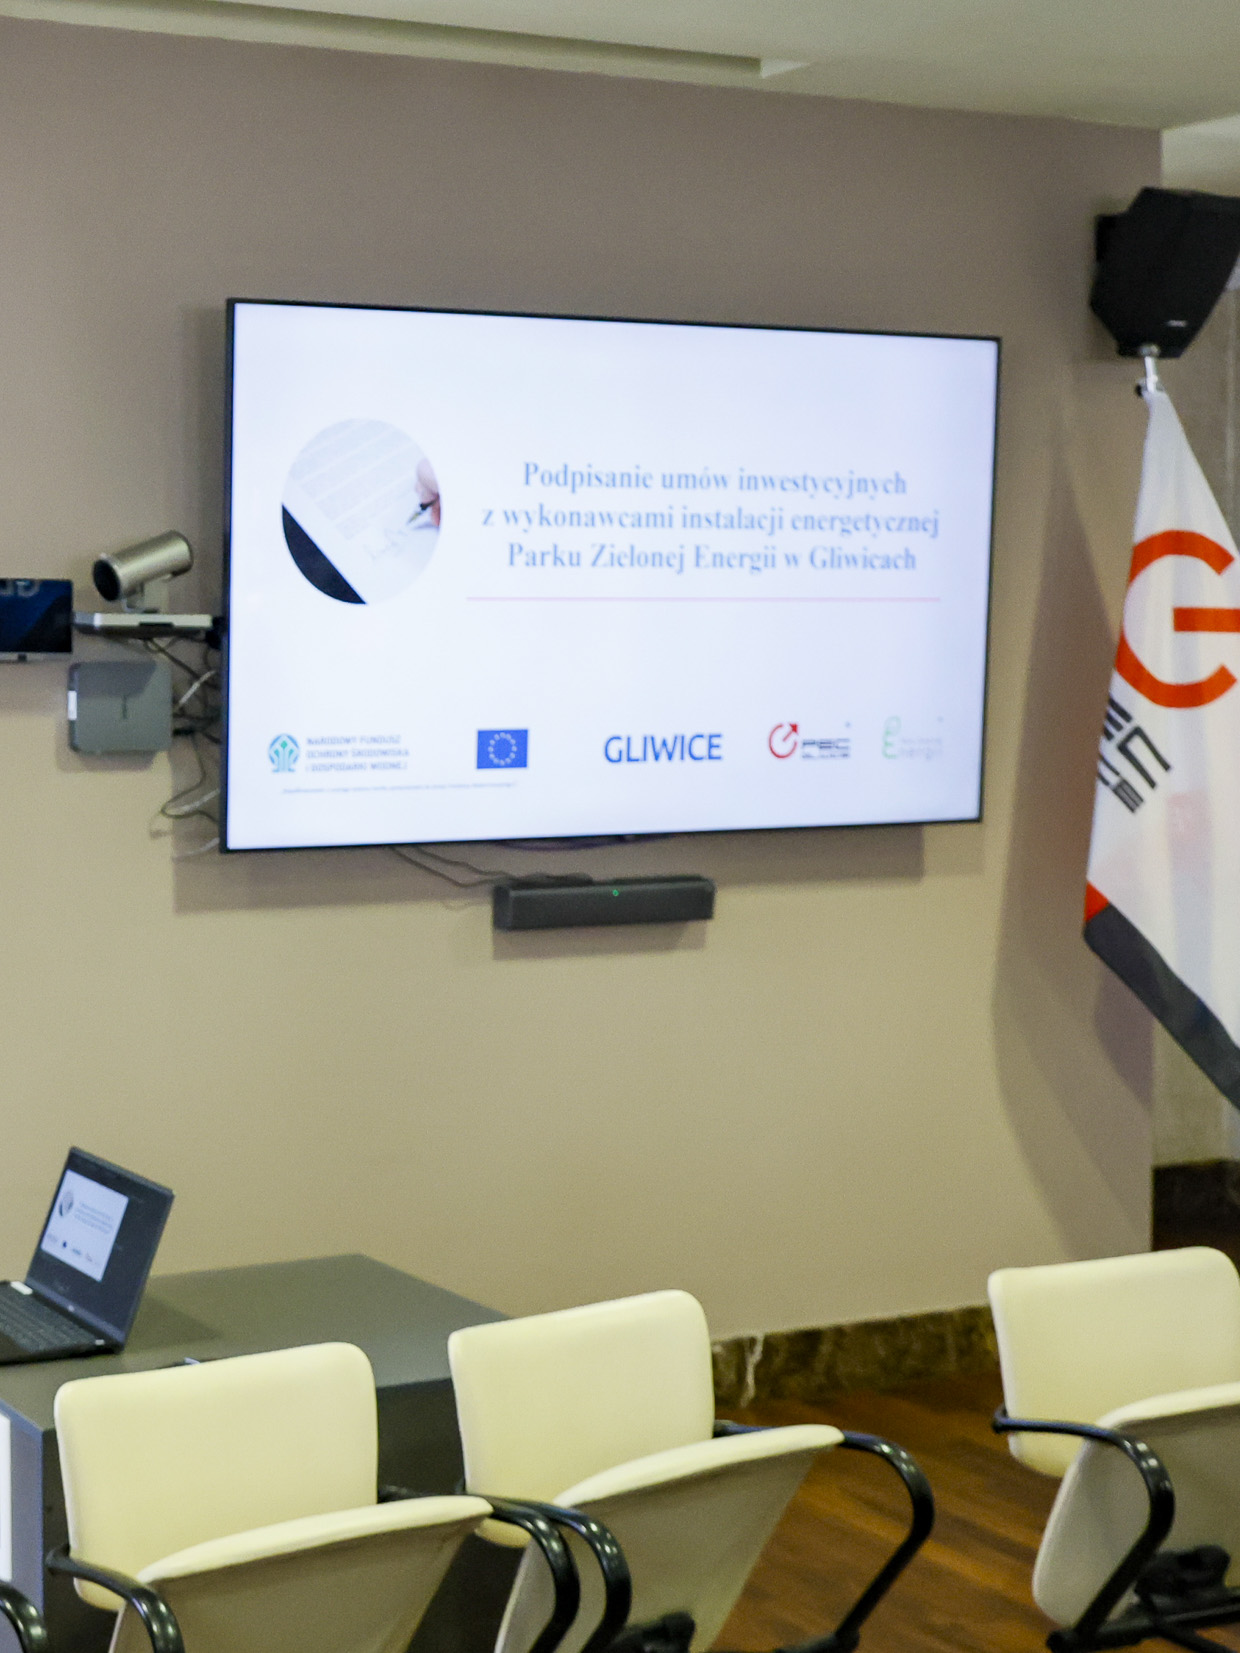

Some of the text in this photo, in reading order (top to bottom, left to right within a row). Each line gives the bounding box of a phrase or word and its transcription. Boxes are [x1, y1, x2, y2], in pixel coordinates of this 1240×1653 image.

[523, 462, 907, 499] Podpisanie umów inwestycyjnych
[482, 503, 940, 539] z wykonawcami instalacji energetycznej
[509, 542, 917, 574] Parku Zielonej Energii w Gliwicach
[604, 734, 723, 763] GLIWICE
